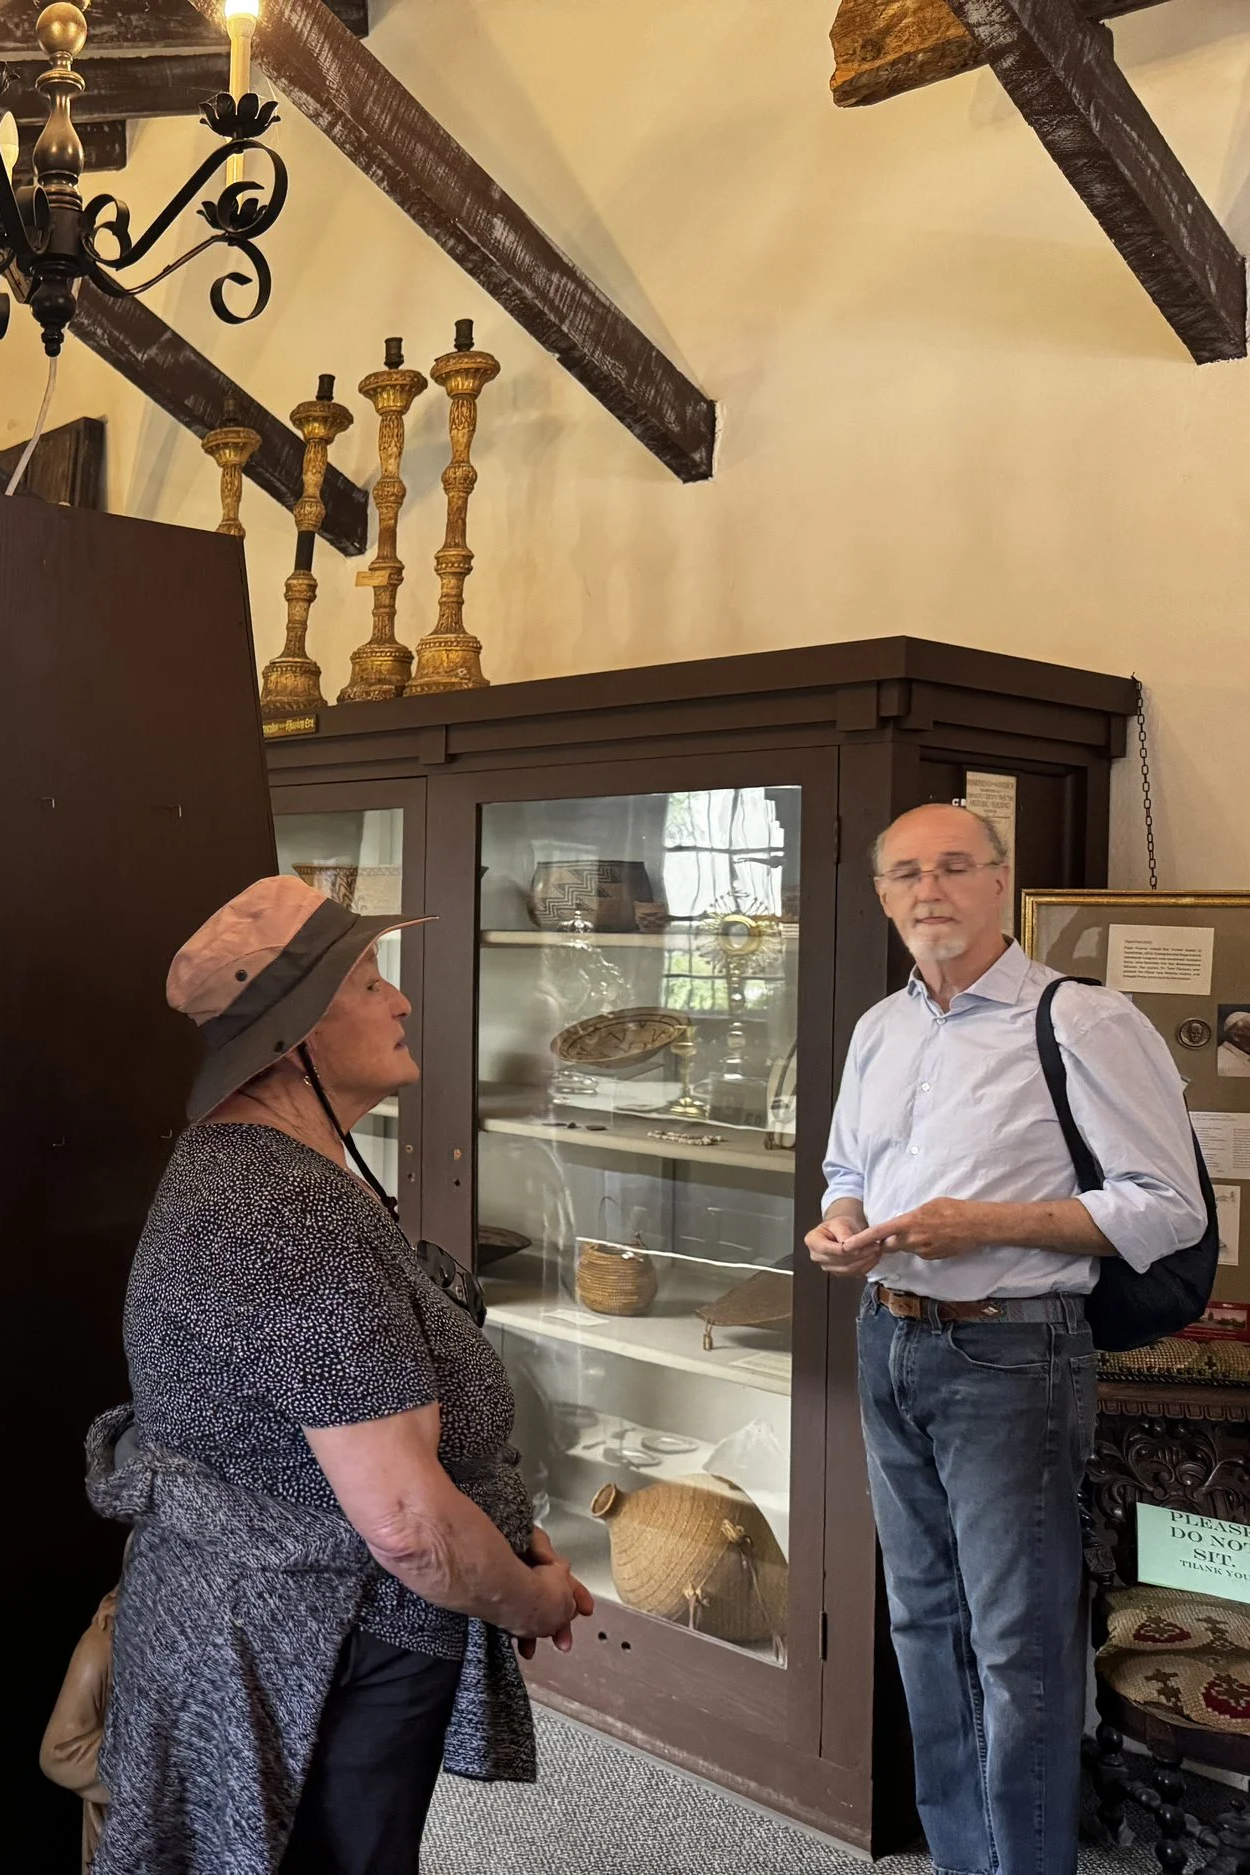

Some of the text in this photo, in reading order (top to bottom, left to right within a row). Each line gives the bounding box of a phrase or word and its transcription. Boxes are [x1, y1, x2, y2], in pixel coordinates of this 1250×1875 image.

[1170, 1526, 1203, 1543] DO
[1193, 1547, 1236, 1568] SIT.
[1179, 1559, 1222, 1575] THANK
